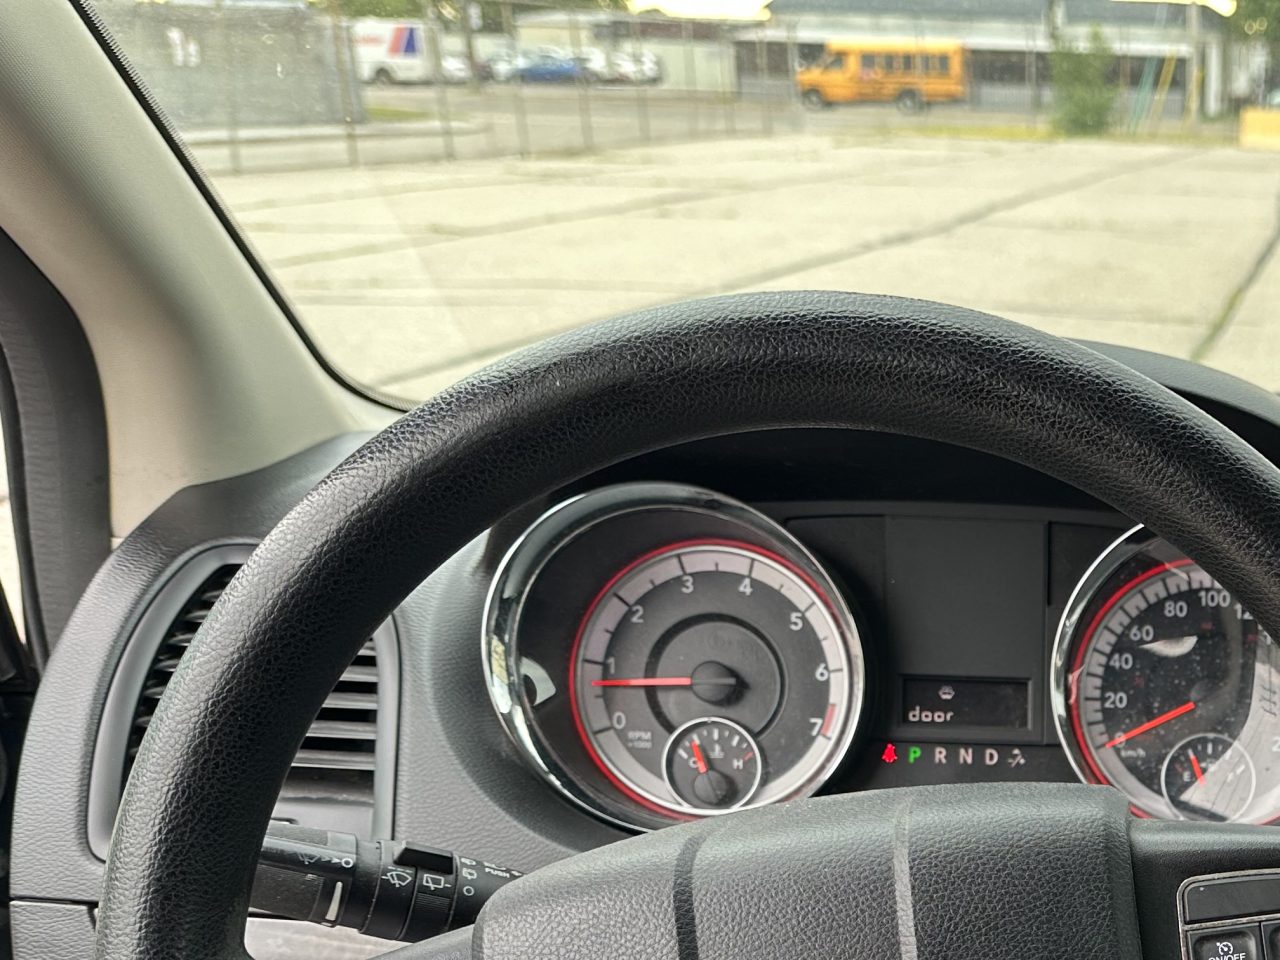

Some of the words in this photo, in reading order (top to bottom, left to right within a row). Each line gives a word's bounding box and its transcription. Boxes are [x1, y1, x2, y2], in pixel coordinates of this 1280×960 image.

[681, 575, 694, 594] 3
[738, 577, 753, 596] 4
[1199, 590, 1231, 608] 100
[631, 606, 644, 623] 2
[1164, 601, 1188, 618] 80
[789, 611, 803, 631] 5
[1129, 625, 1154, 642] 60
[607, 656, 616, 675] 1
[1109, 653, 1133, 670] 40
[815, 665, 828, 682] 6
[1104, 692, 1128, 709] 20
[613, 712, 626, 729] 0
[908, 705, 954, 723] door
[809, 718, 823, 737] 7
[733, 759, 743, 769] H
[908, 746, 921, 764] P
[934, 746, 947, 764] R
[959, 747, 973, 764] N
[985, 748, 999, 765] D
[1183, 771, 1191, 782] E
[485, 867, 510, 878] PUSH
